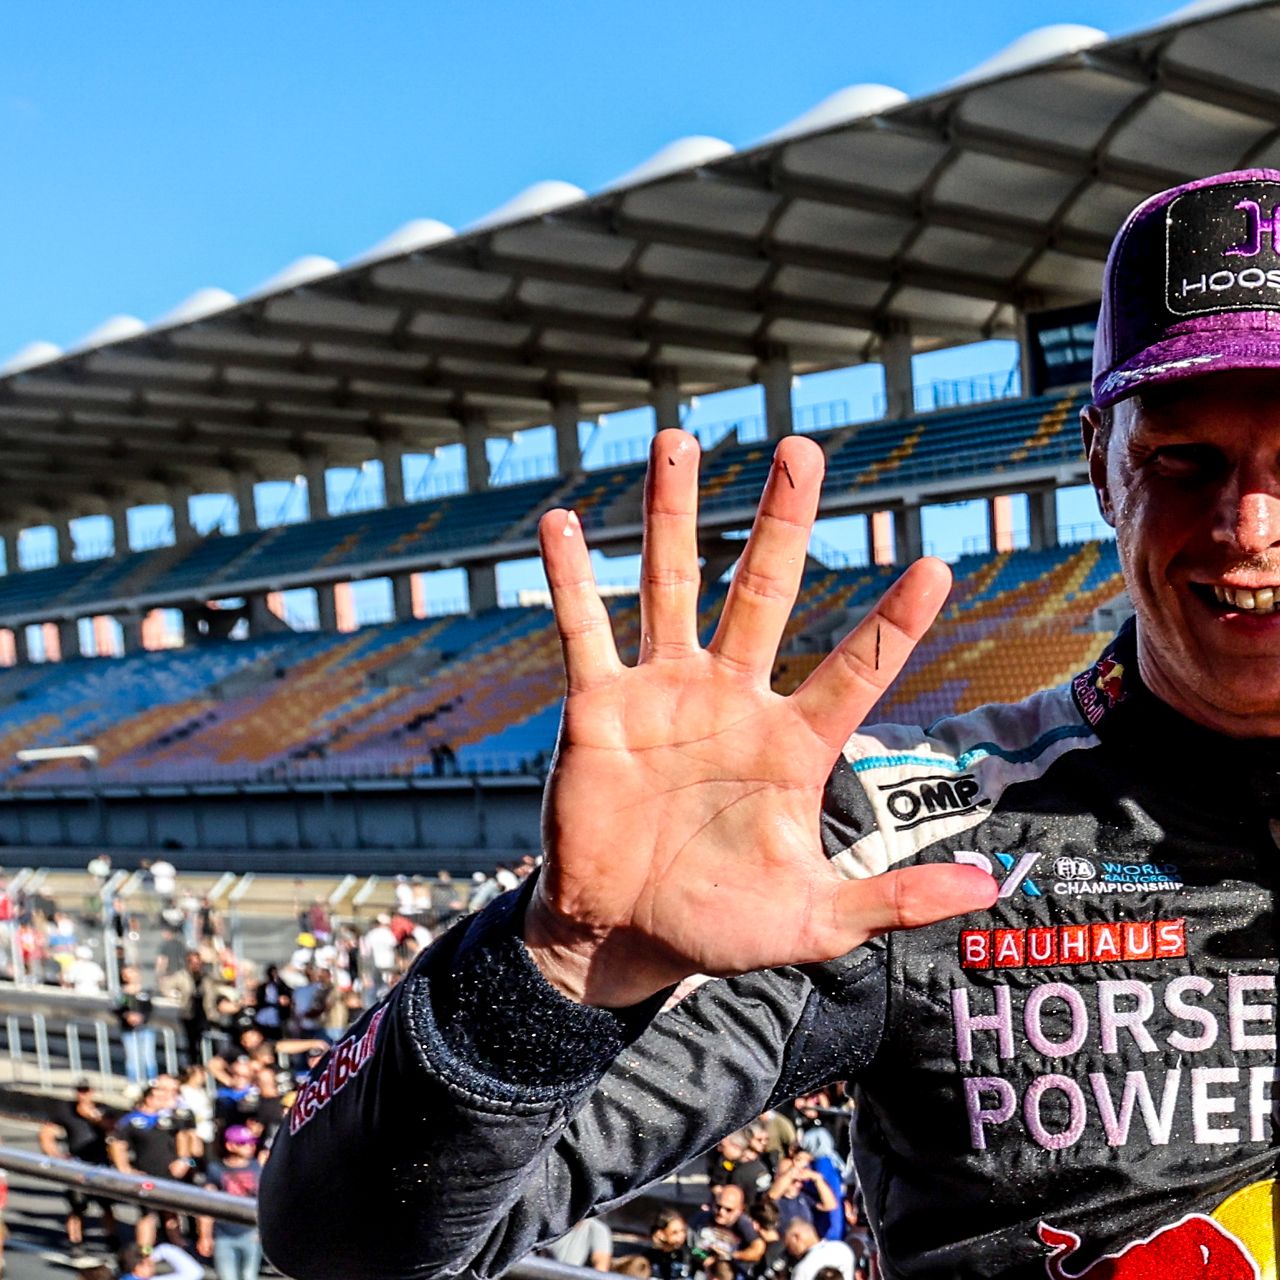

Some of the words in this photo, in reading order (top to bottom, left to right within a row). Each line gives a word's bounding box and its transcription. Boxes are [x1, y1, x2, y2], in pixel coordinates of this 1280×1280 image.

[885, 777, 981, 822] OMP
[1101, 861, 1179, 875] WORLD
[1053, 881, 1184, 896] CHAMPIONSHIP
[964, 923, 1184, 963] BAUHAUS
[950, 973, 1278, 1062] HORSE
